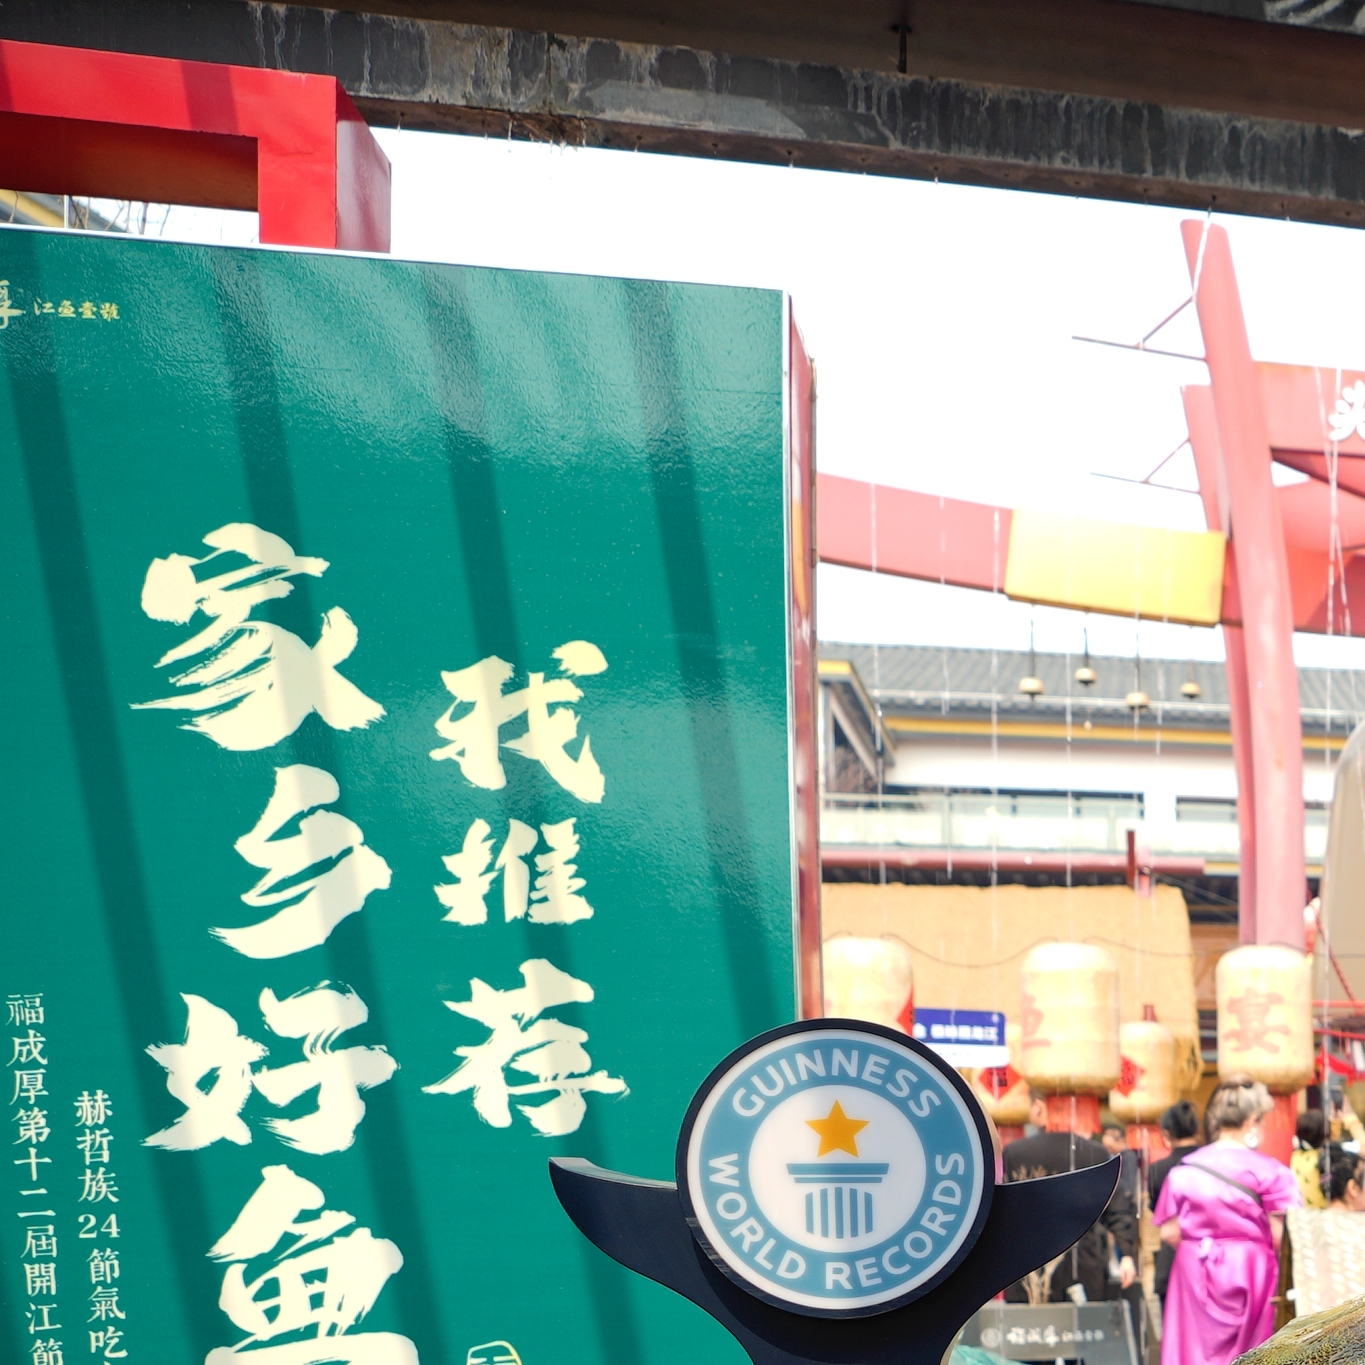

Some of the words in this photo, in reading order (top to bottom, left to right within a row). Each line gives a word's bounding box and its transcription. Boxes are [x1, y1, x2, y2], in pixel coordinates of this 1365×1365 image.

[420, 639, 631, 1137] 我推荐
[732, 1048, 942, 1118] GUINNESS
[708, 1152, 807, 1280] WORLD
[824, 1152, 965, 1290] RECORDS
